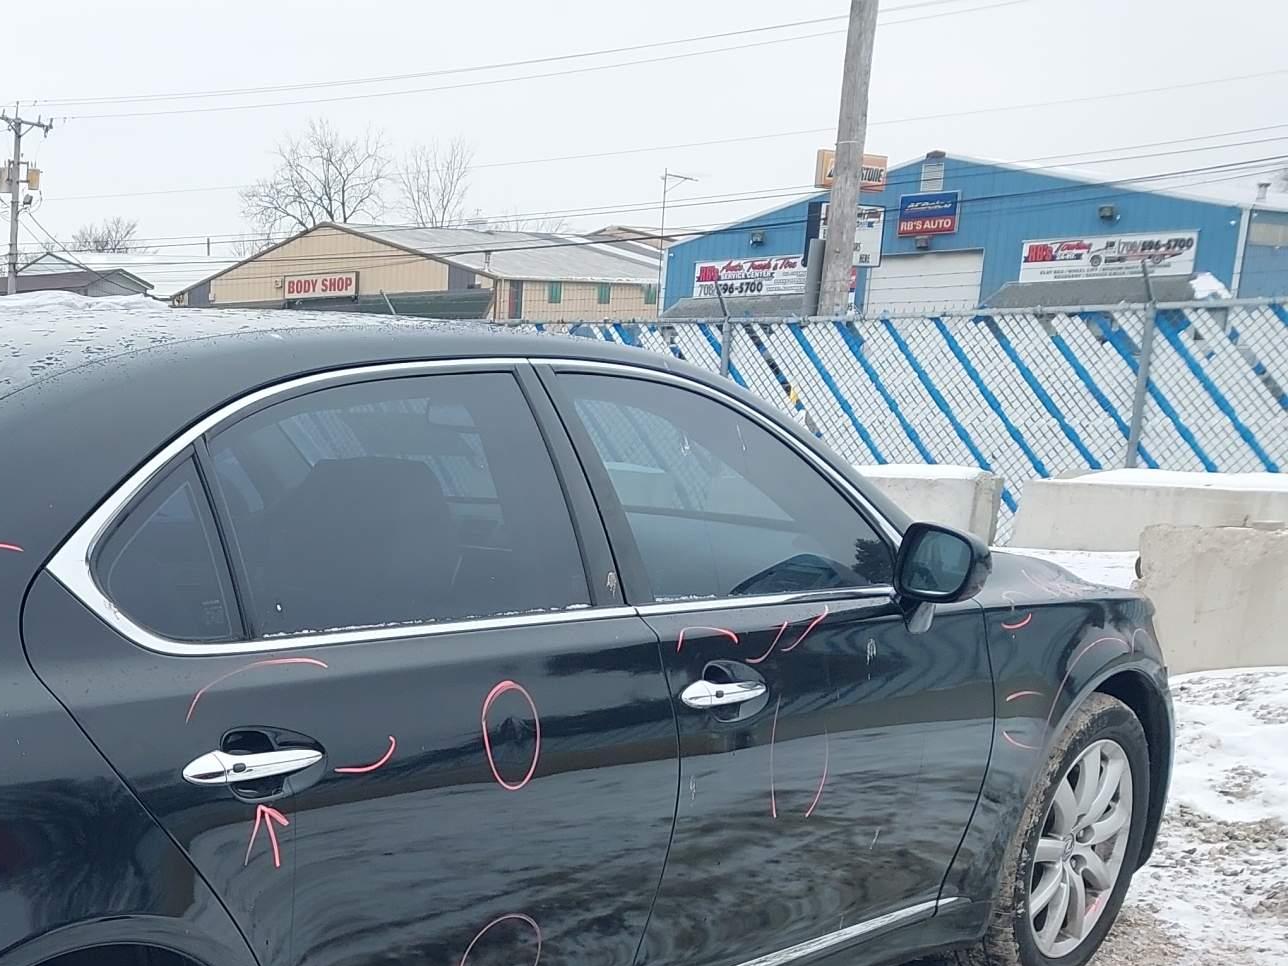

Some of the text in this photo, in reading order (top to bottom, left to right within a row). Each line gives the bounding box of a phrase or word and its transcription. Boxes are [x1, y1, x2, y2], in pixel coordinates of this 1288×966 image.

[900, 218, 952, 231] RB'S AUTO
[747, 270, 771, 279] CENTER
[287, 276, 353, 294] BODY SHOP
